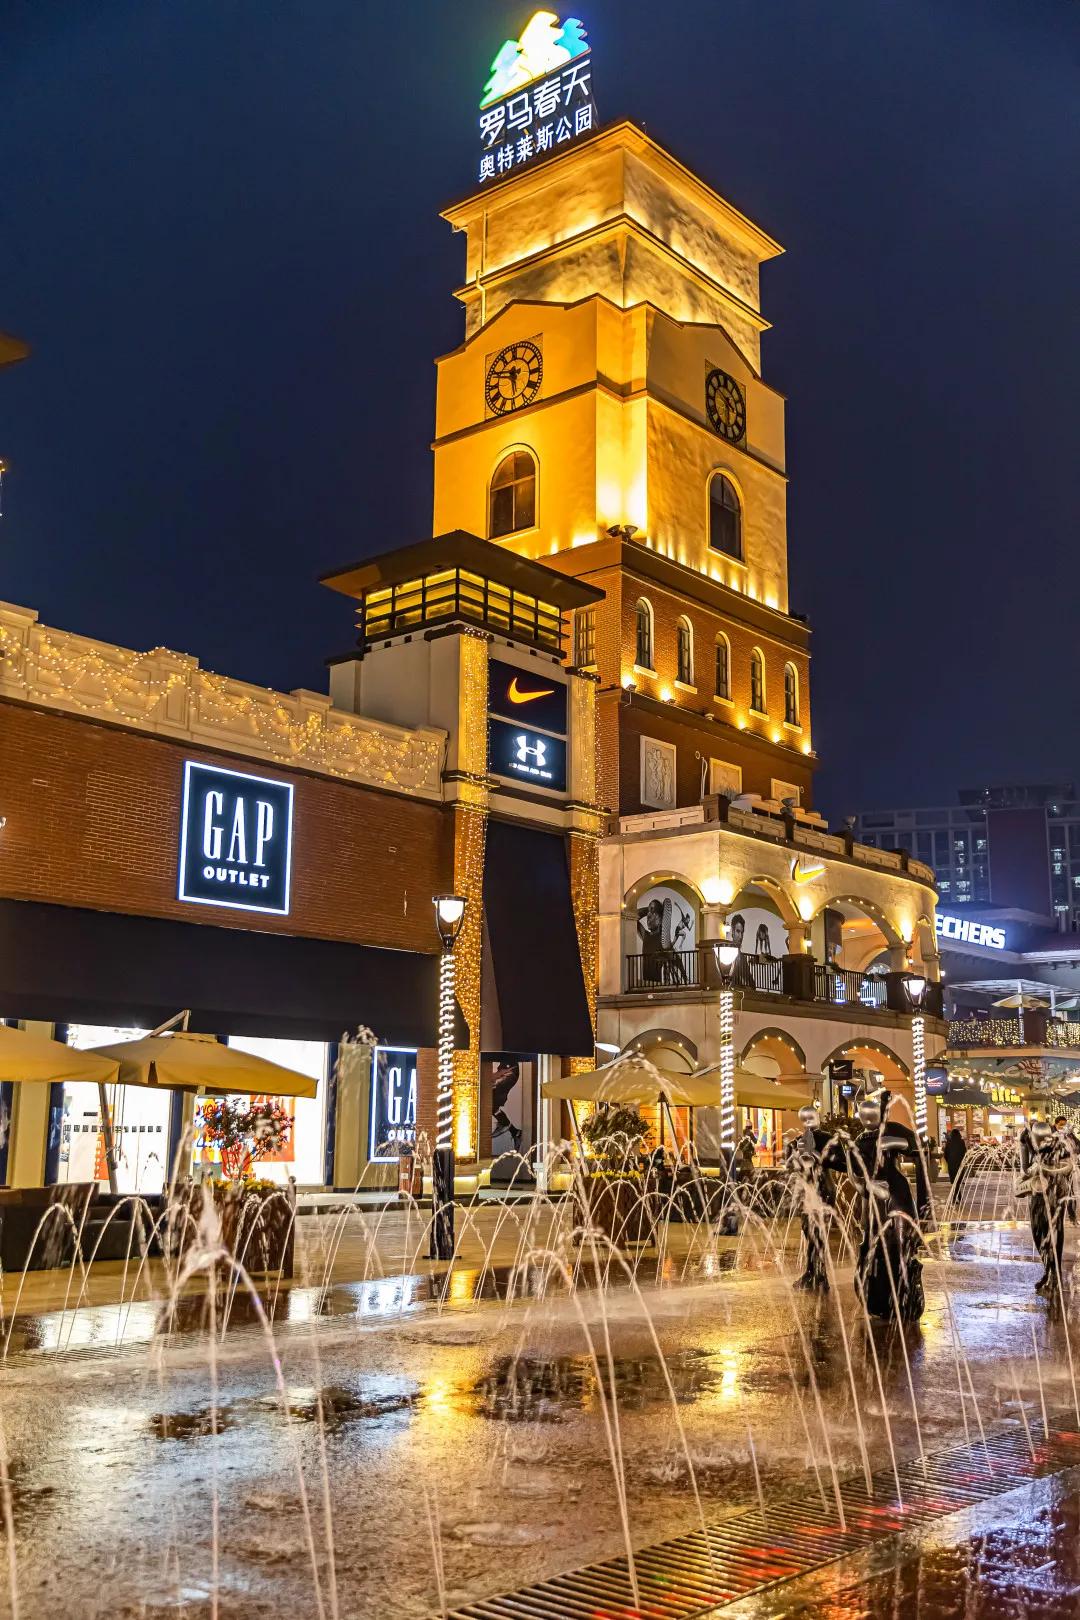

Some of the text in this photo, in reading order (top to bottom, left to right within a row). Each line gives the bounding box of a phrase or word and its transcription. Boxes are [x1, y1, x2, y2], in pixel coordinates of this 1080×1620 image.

[479, 59, 591, 146] 罗马春天
[479, 104, 592, 183] 奥特莱斯公园
[203, 790, 274, 866] GAP
[203, 866, 270, 888] OUTLET
[387, 1129, 417, 1142] OUT
